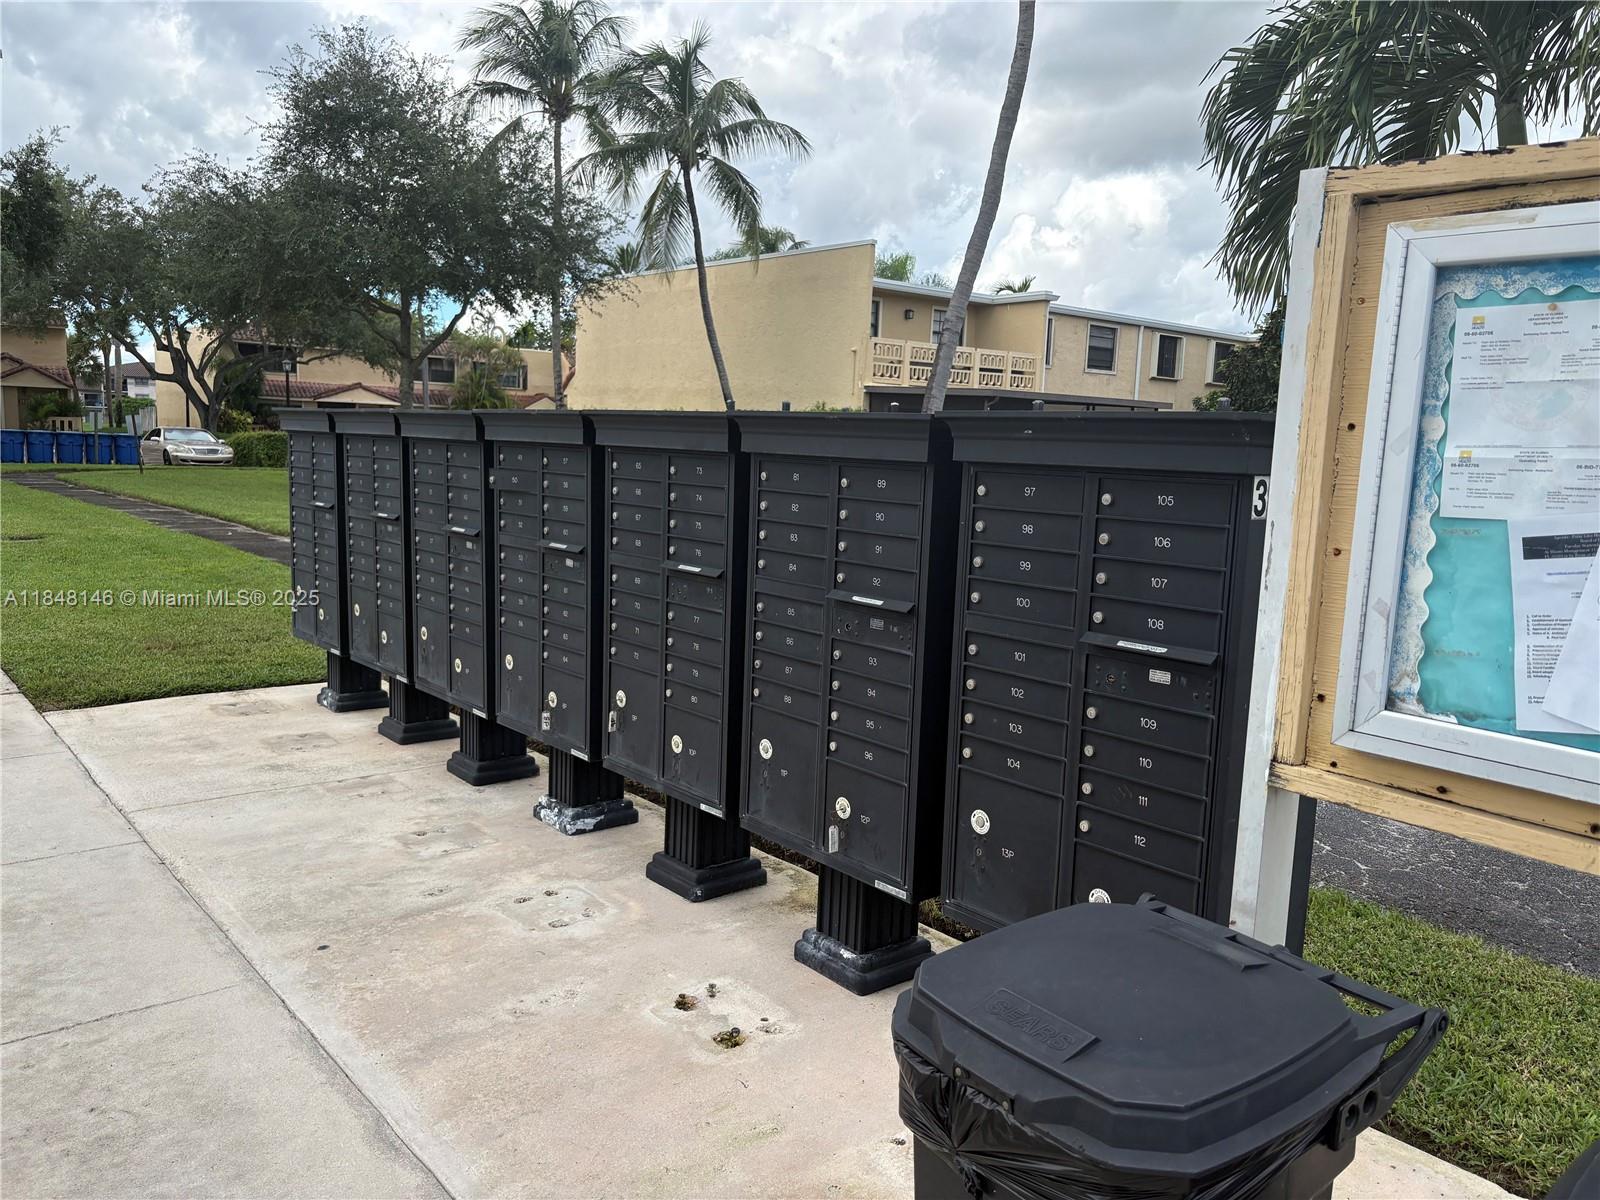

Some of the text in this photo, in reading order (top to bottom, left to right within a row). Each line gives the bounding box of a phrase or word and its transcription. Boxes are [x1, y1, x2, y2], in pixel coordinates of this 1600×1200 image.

[792, 472, 800, 482] 81
[876, 479, 887, 489] 89
[1024, 486, 1036, 497] 97
[1157, 495, 1175, 507] 105
[1254, 479, 1268, 517] 3
[791, 503, 800, 513] 82
[875, 512, 885, 522] 90
[1021, 523, 1034, 535] 98
[790, 533, 799, 543] 83
[1154, 536, 1171, 548] 106
[874, 544, 883, 554] 91
[788, 563, 797, 572] 84
[1019, 560, 1032, 572] 99
[872, 577, 881, 587] 92
[1151, 577, 1168, 589] 107
[1016, 597, 1031, 608] 100
[787, 607, 796, 617] 85
[1147, 618, 1165, 631] 108
[785, 636, 794, 646] 86
[868, 656, 878, 667] 93
[1014, 651, 1026, 662] 101
[784, 665, 793, 675] 87
[866, 687, 876, 697] 94
[1010, 687, 1025, 699] 102
[783, 694, 792, 704] 88
[865, 719, 875, 729] 95
[1008, 722, 1023, 735] 103
[1140, 717, 1158, 730] 109
[864, 750, 874, 761] 96
[1006, 757, 1021, 771] 104
[1139, 756, 1153, 769] 110
[1138, 795, 1148, 807] 111
[860, 814, 871, 825] 12P
[1133, 834, 1147, 848] 112
[1001, 847, 1015, 859] 13P
[990, 1000, 1073, 1051] SEARS
